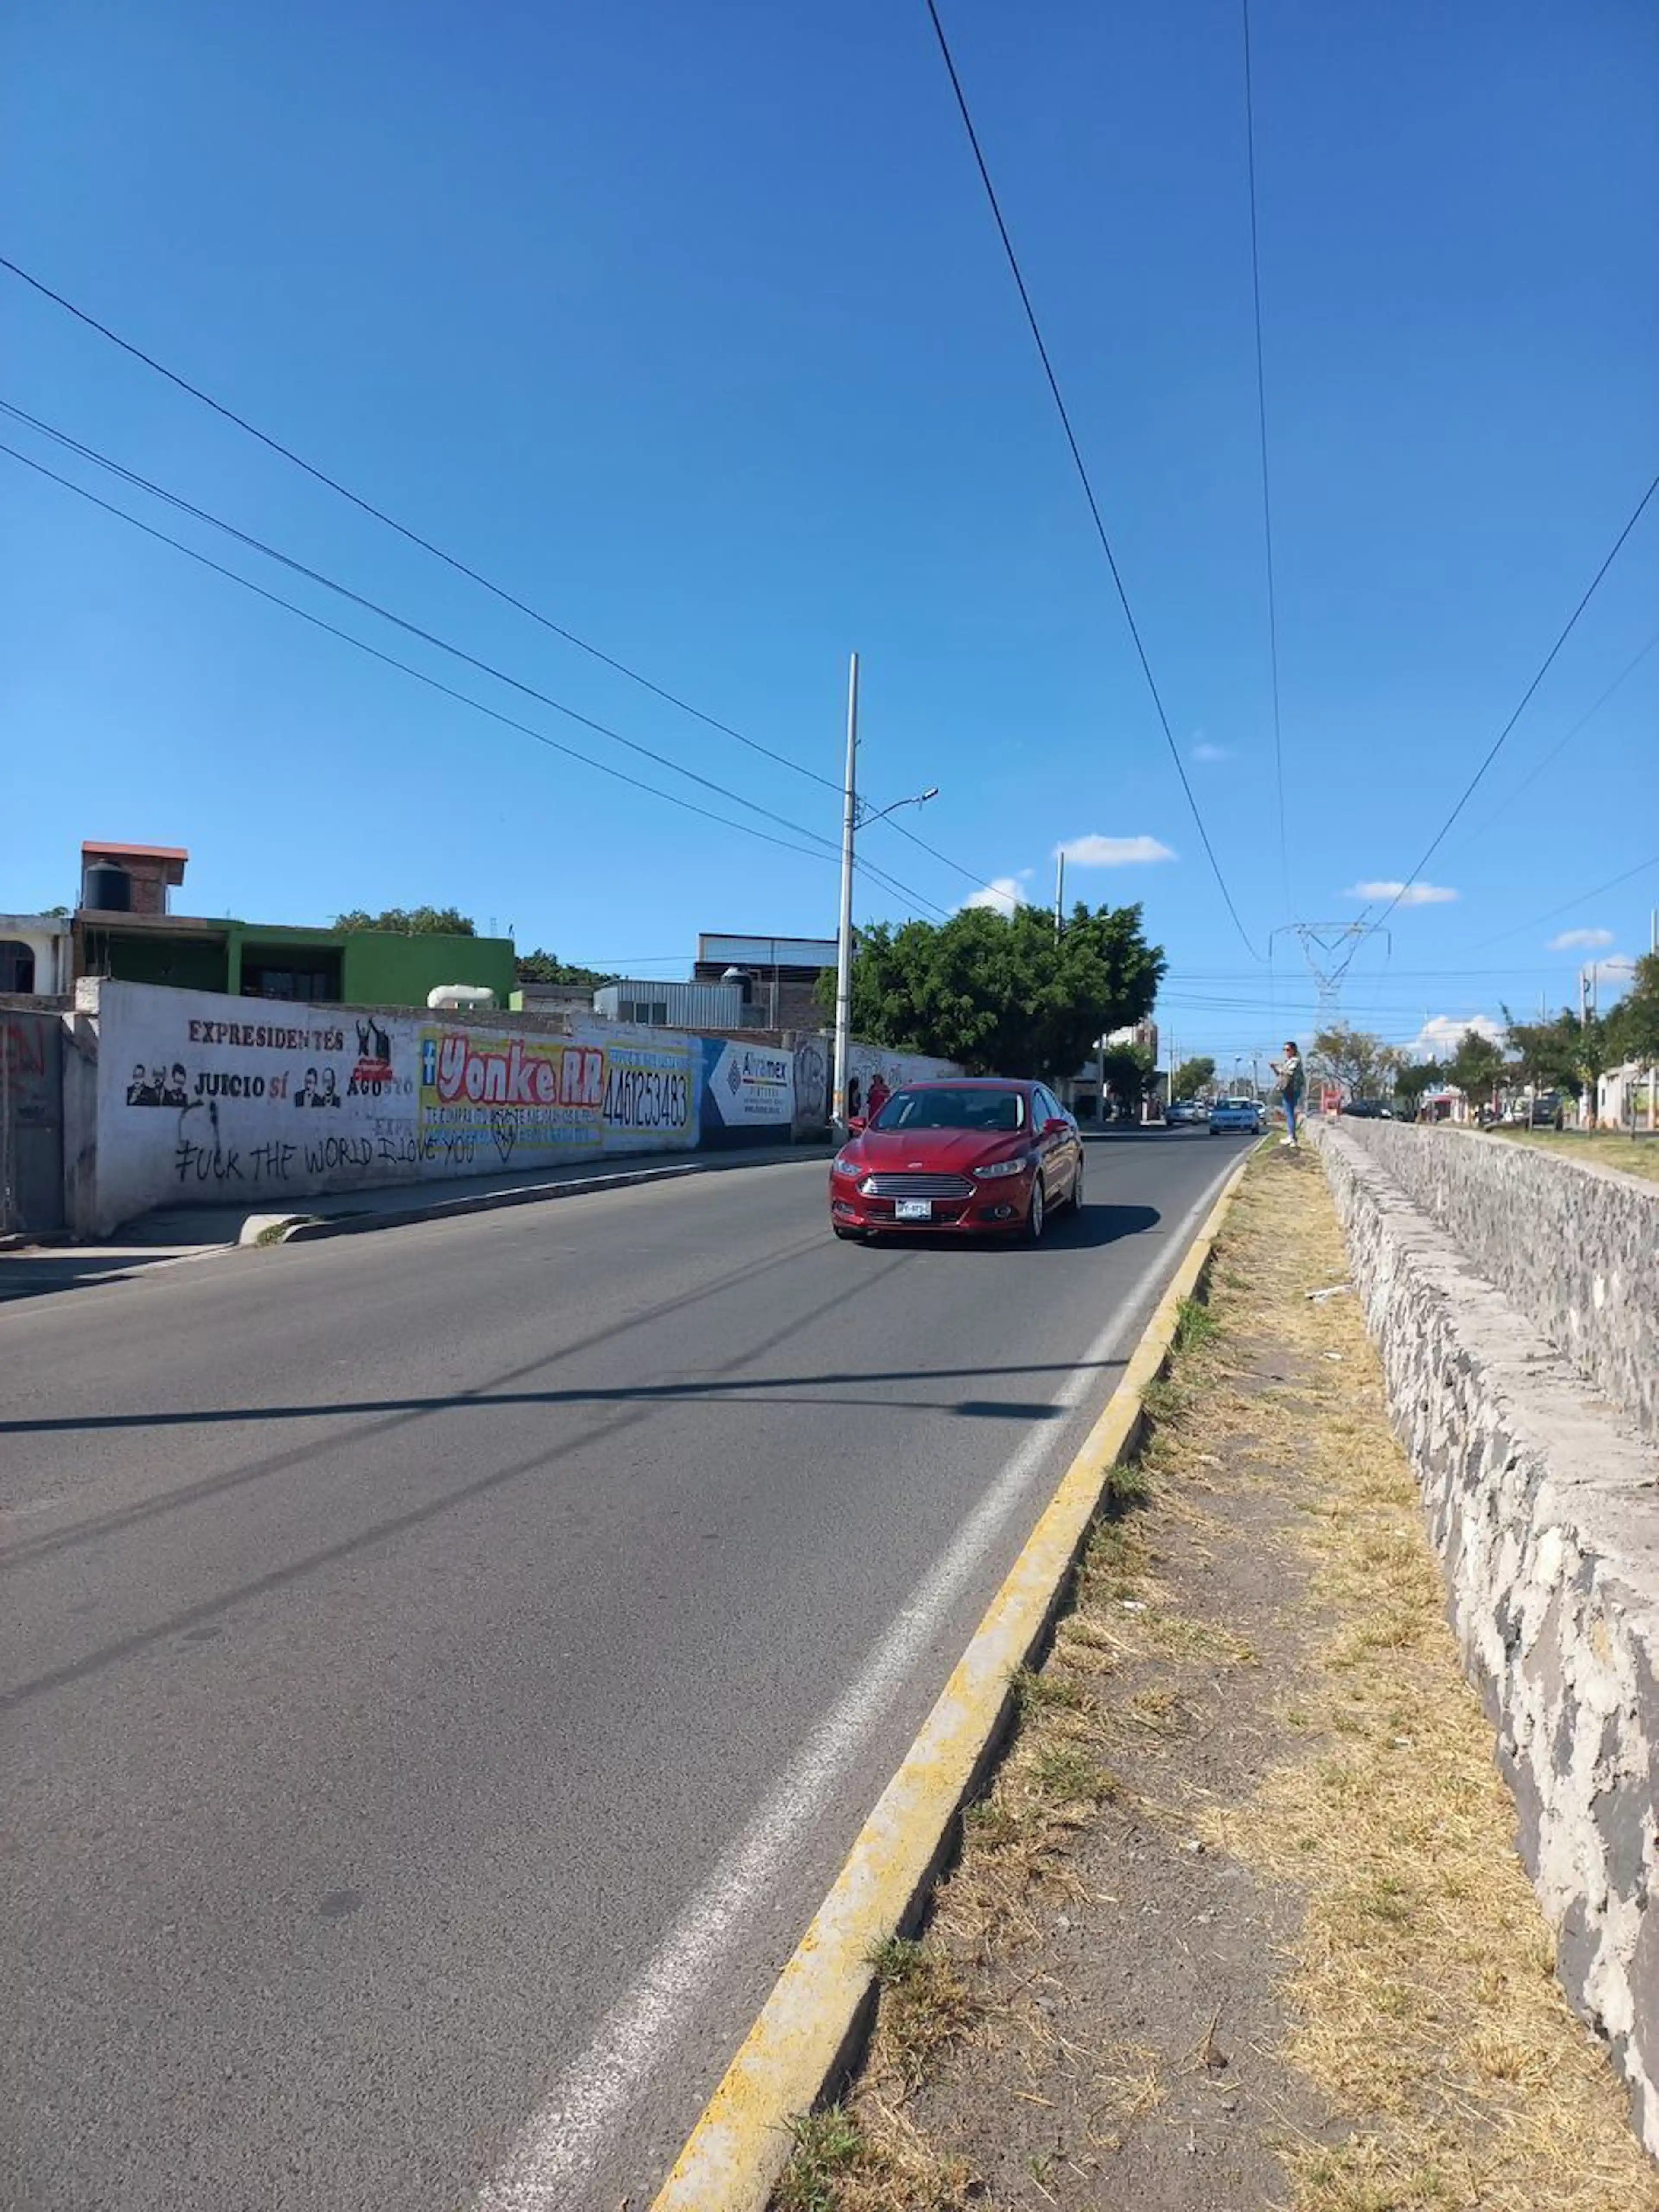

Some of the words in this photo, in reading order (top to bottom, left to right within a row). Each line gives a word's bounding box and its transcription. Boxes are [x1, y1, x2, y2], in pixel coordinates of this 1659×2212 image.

[194, 1072, 265, 1098] JUICIO
[437, 1033, 556, 1106] Yonke
[175, 1139, 244, 1182] FUCK
[250, 1140, 298, 1181] THE
[304, 1137, 373, 1173] WORLD
[442, 1133, 474, 1165] YOU
